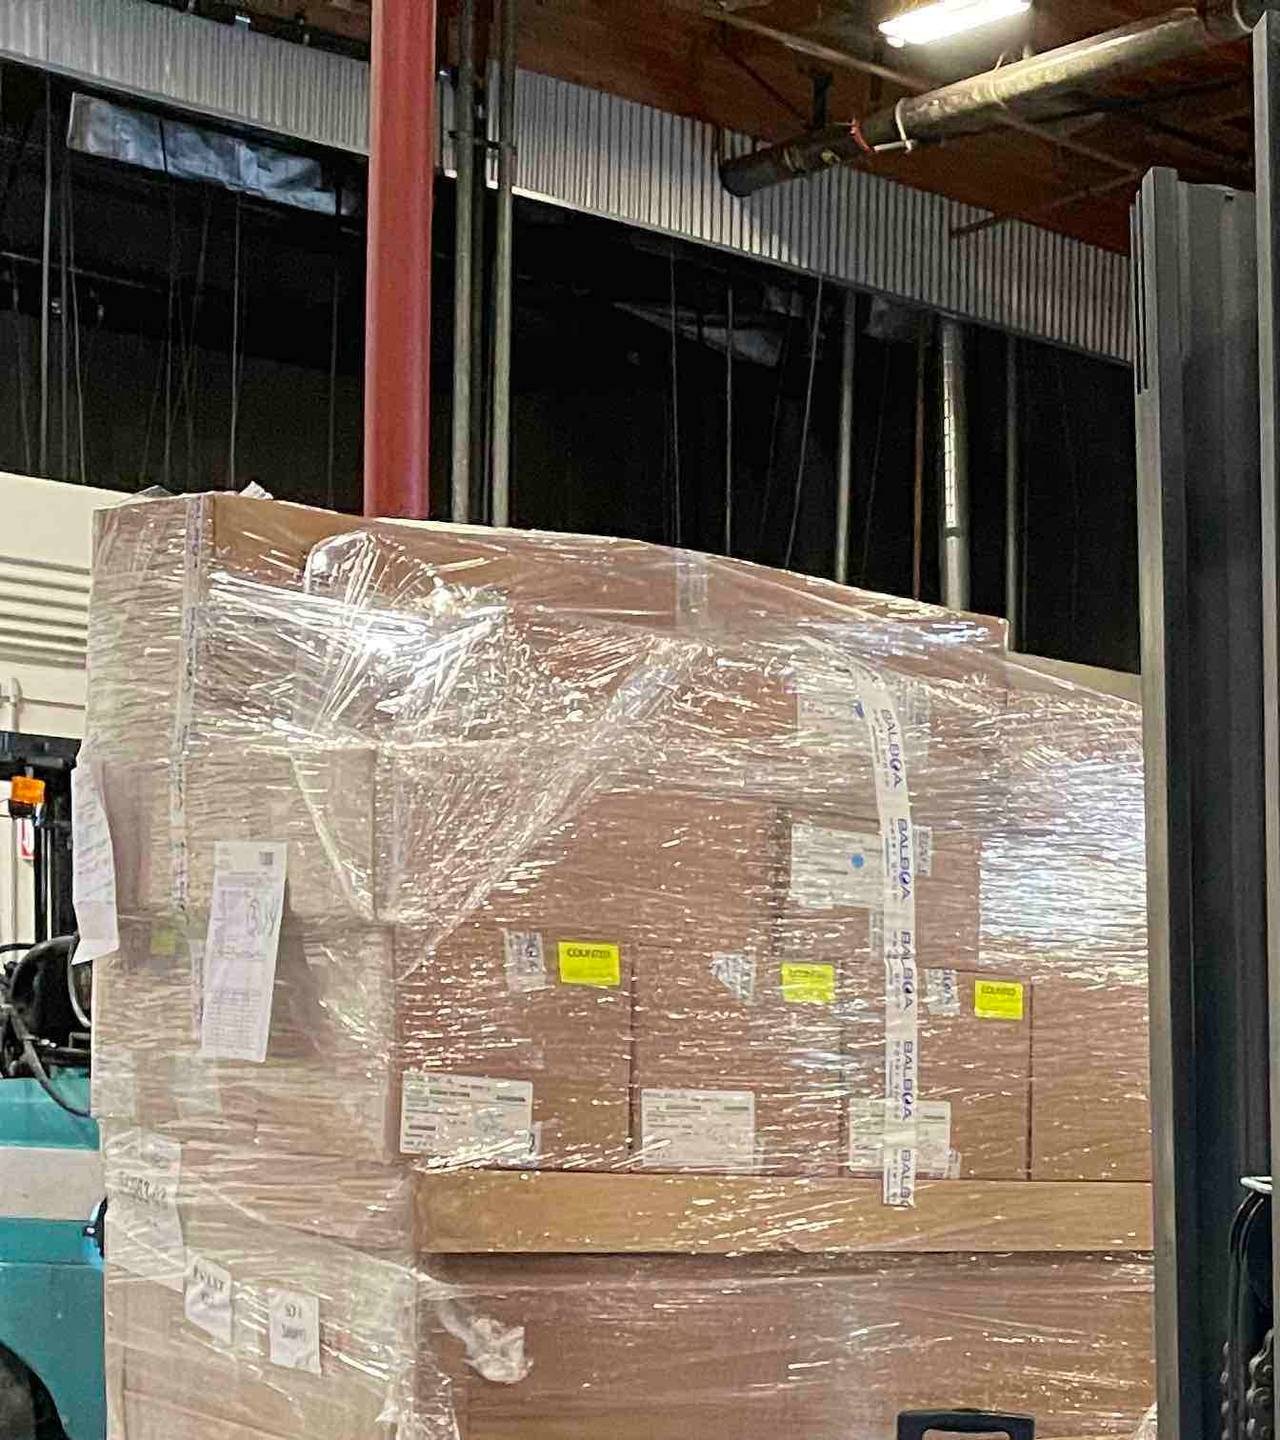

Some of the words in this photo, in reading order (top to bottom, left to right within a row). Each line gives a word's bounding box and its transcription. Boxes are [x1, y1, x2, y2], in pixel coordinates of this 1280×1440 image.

[880, 709, 903, 788] BALBOA
[897, 818, 912, 901] BALBOA
[901, 931, 915, 1010] BALBOA
[902, 1040, 914, 1121] BALBOA
